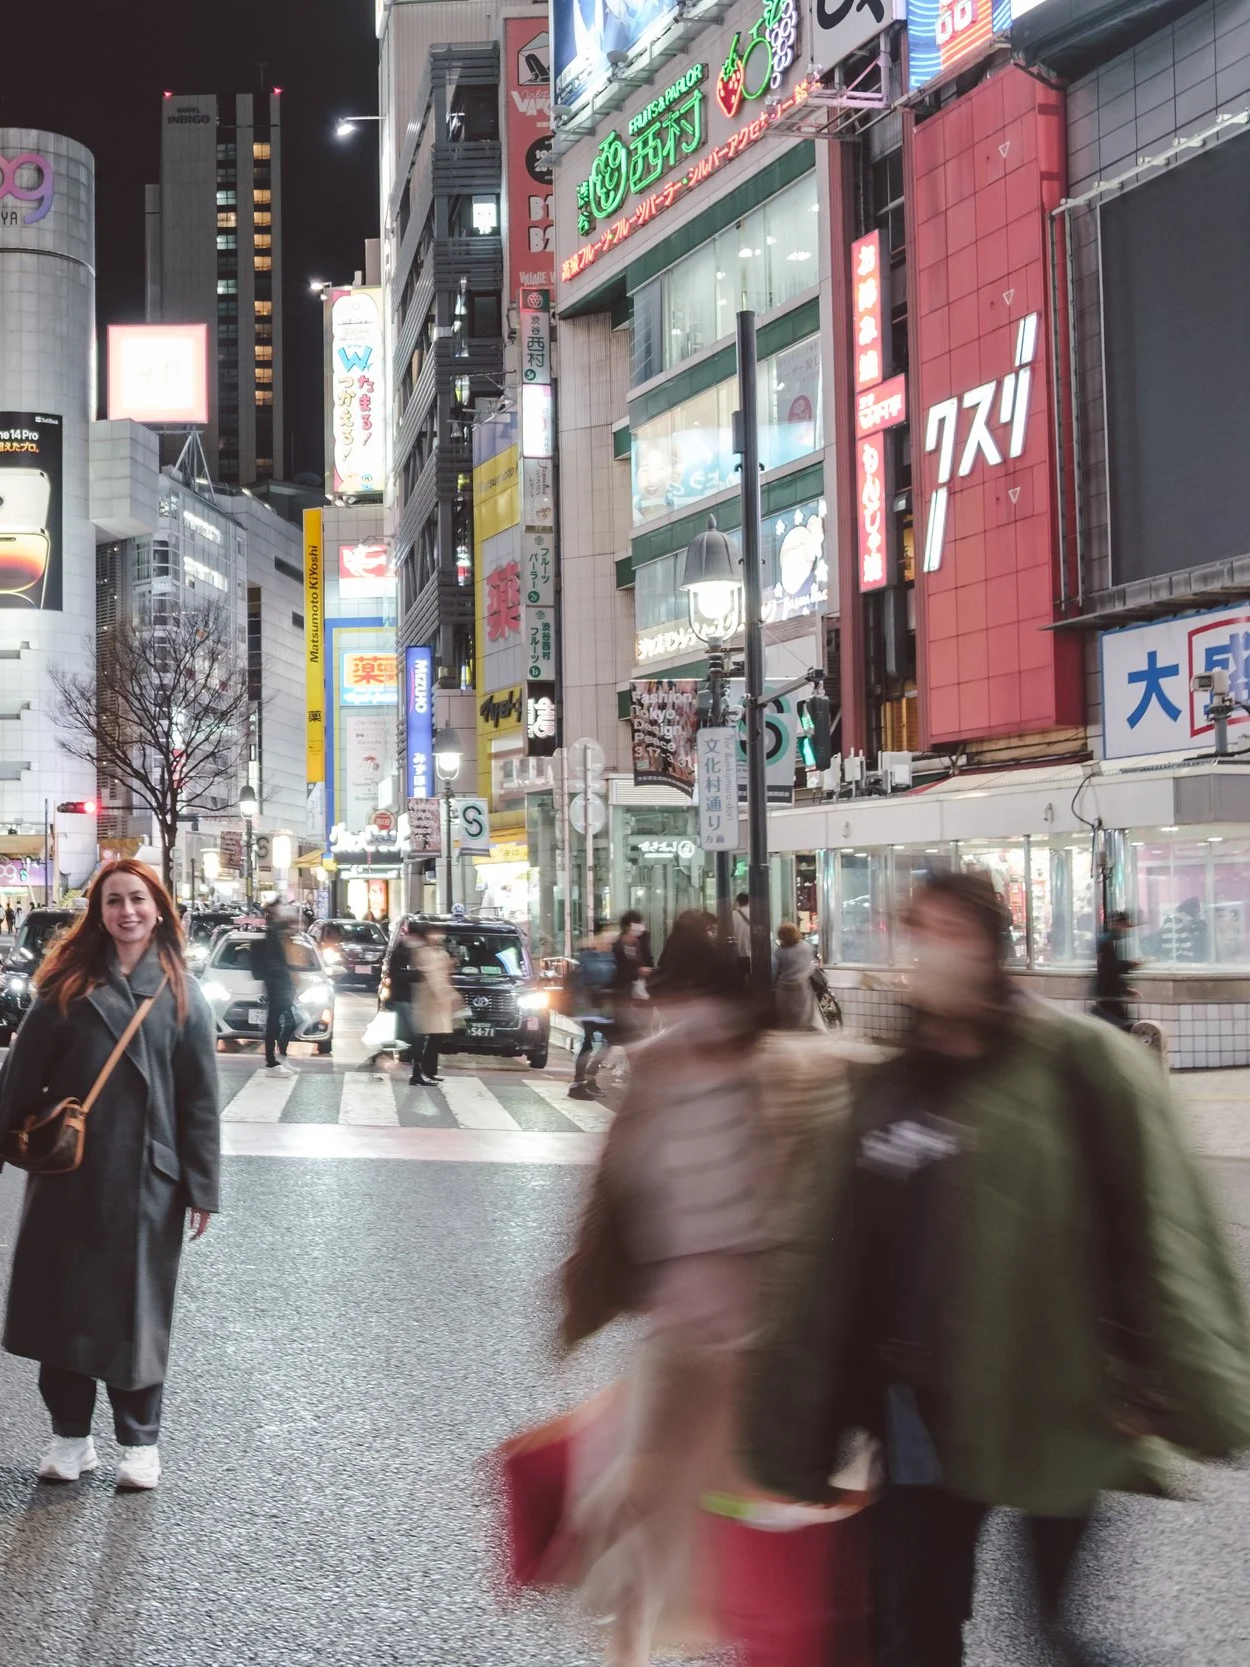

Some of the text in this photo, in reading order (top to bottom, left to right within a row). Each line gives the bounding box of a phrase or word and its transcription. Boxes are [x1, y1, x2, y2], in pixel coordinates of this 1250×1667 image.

[10, 429, 21, 440] 14
[22, 430, 39, 441] Pro
[540, 548, 550, 585] フルーツ
[487, 561, 521, 642] 薬
[309, 592, 320, 663] Matsumoto
[530, 627, 540, 664] フルーツ
[414, 659, 428, 714] MIZUHO
[634, 732, 676, 752] Peace
[704, 737, 723, 832] 文化村通り
